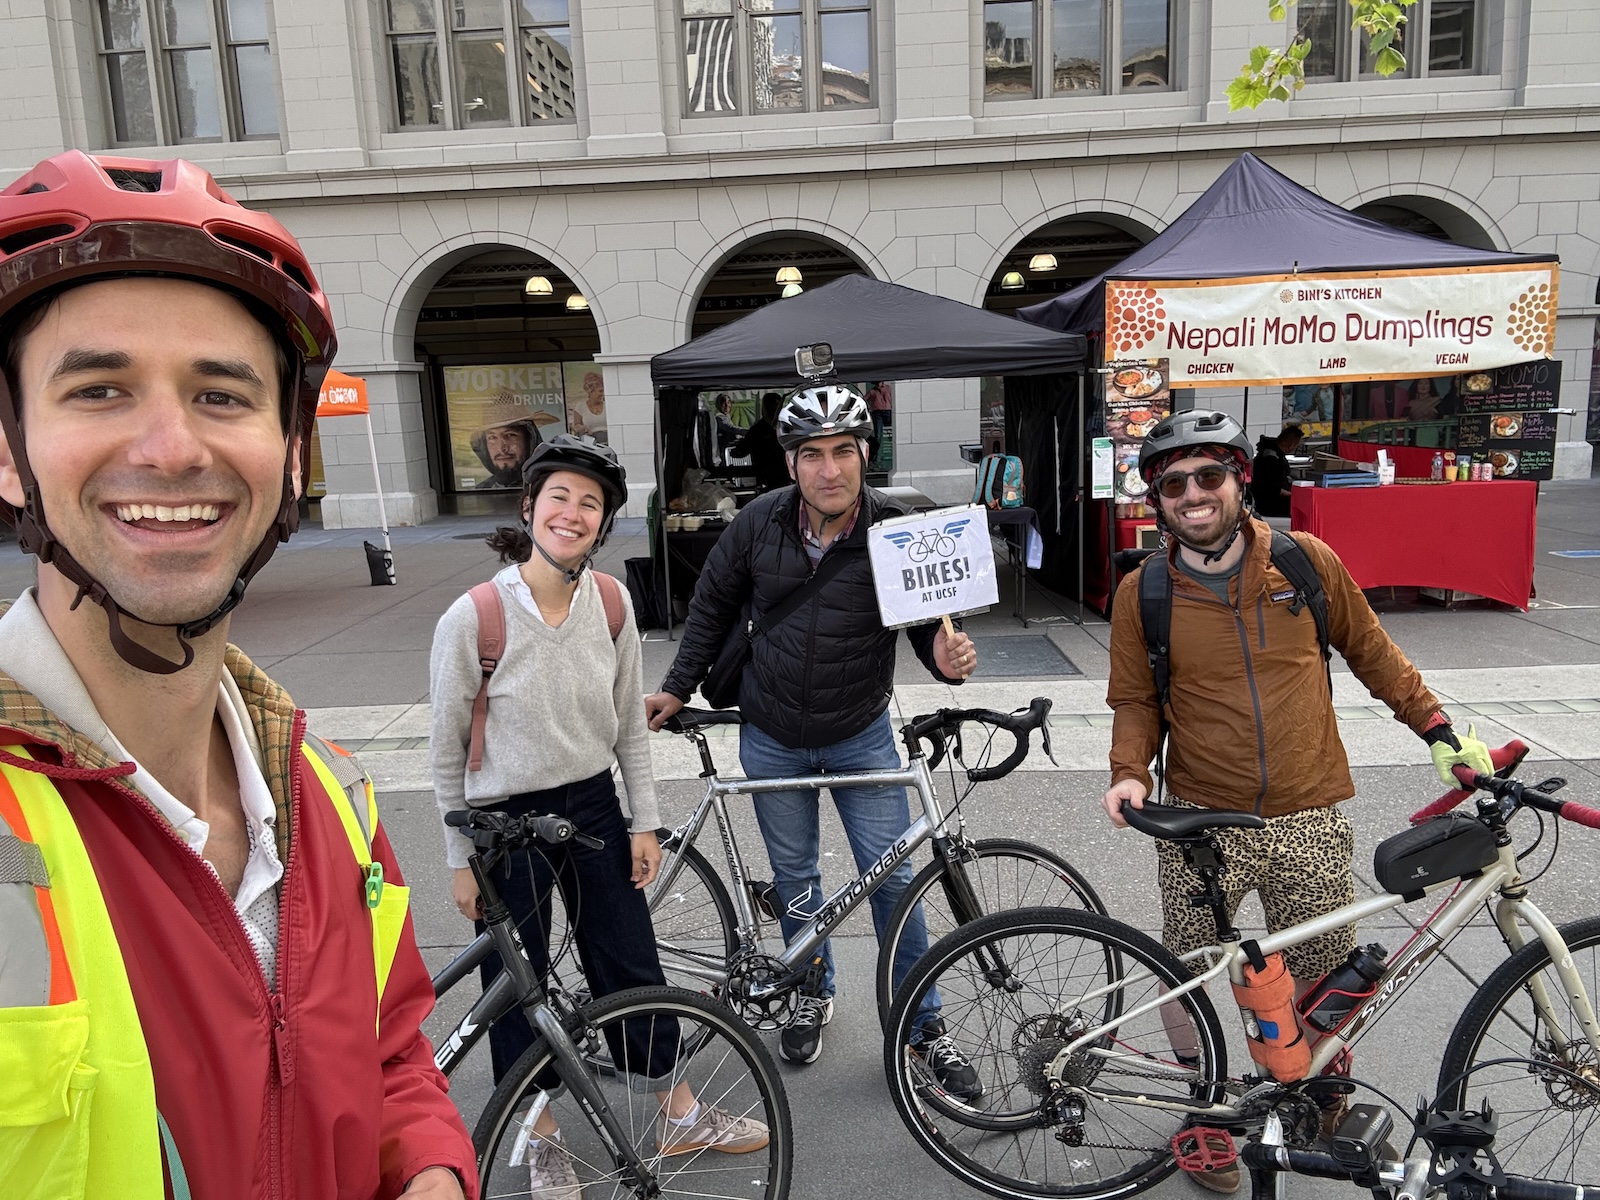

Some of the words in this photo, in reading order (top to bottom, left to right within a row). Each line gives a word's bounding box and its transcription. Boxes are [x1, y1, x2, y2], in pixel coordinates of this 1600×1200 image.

[1297, 288, 1331, 302] BINI'S
[1334, 287, 1383, 301] KITCHEN
[1166, 315, 1256, 357] Nepali
[1263, 314, 1337, 347] MoMo
[1345, 308, 1494, 349] Dumplings
[1187, 361, 1235, 375] CHICKEN
[1319, 357, 1347, 370] LAMB
[1435, 352, 1470, 366] VEGAN
[447, 366, 564, 393] WORKER
[513, 392, 564, 406] DRIVEN
[901, 555, 972, 592] BIKES!
[921, 591, 933, 604] AT
[935, 586, 958, 601] UCSF
[717, 815, 741, 886] cannondale
[815, 839, 909, 936] cannondale
[433, 1011, 480, 1071] EK
